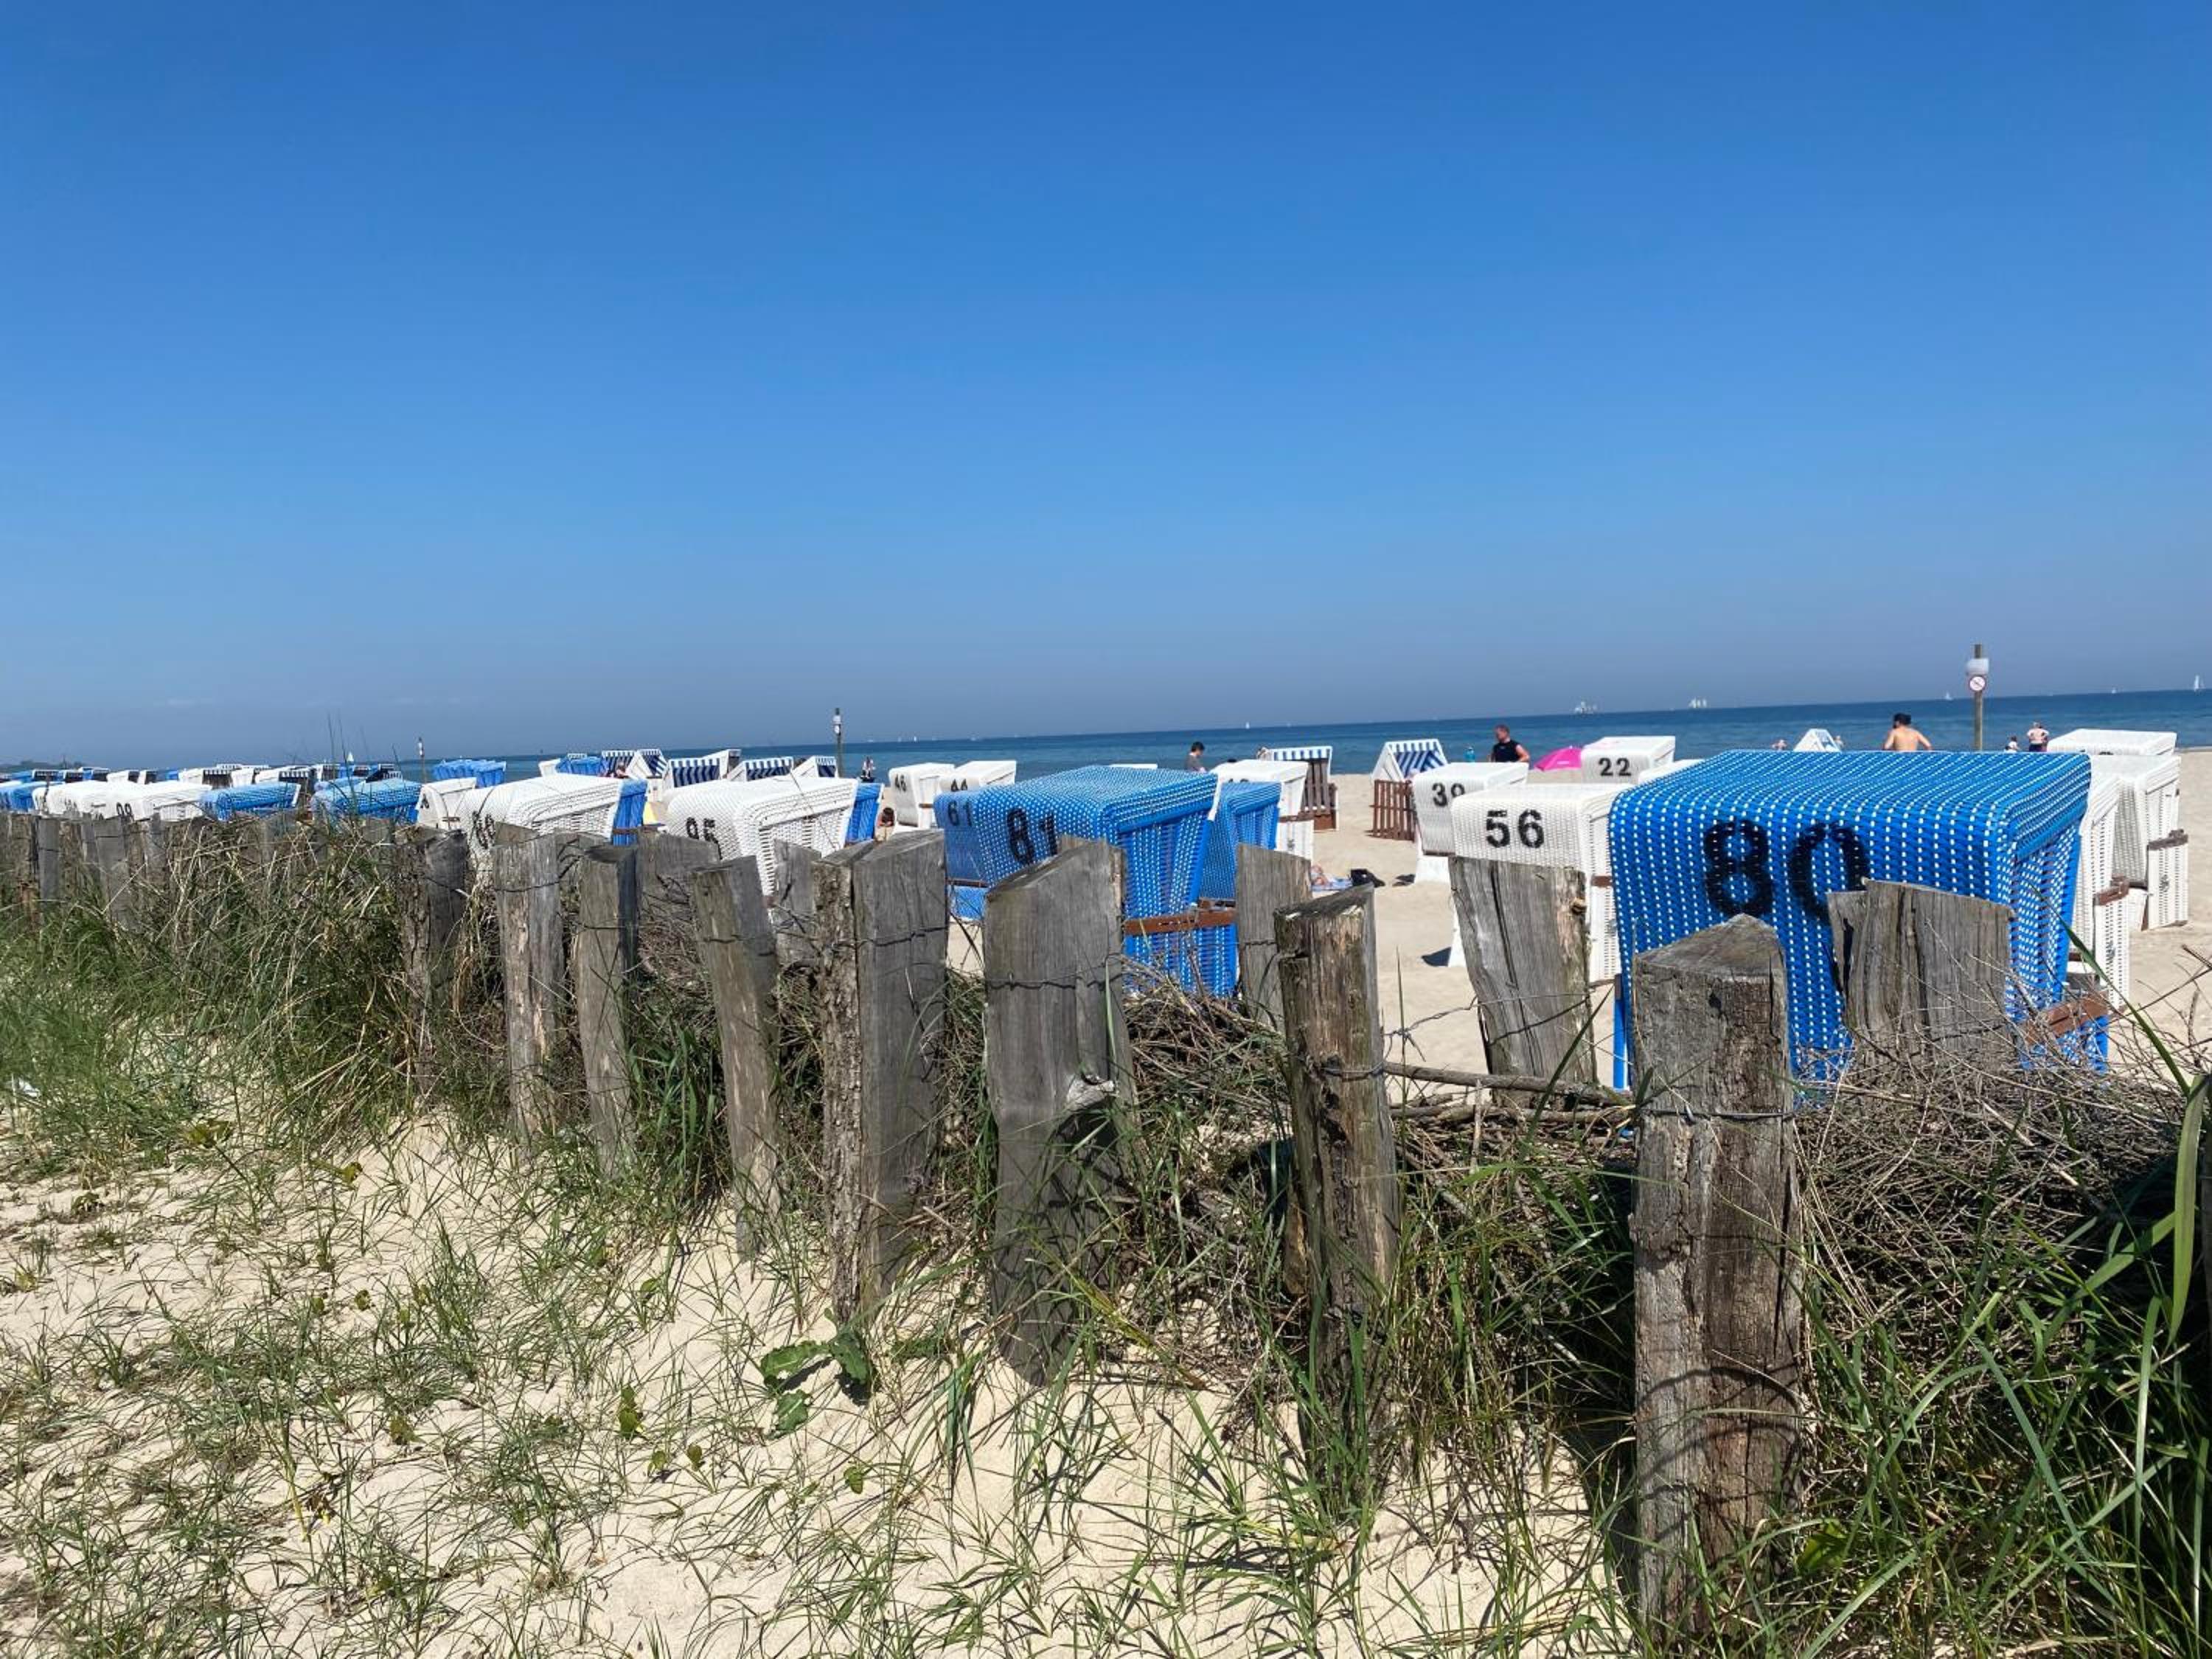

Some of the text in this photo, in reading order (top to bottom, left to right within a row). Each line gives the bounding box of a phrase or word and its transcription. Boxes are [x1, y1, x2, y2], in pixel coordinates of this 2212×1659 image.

[1599, 757, 1632, 776] 22
[1007, 808, 1057, 865] 81
[1486, 809, 1545, 848] 56
[1703, 818, 1870, 922] 80
